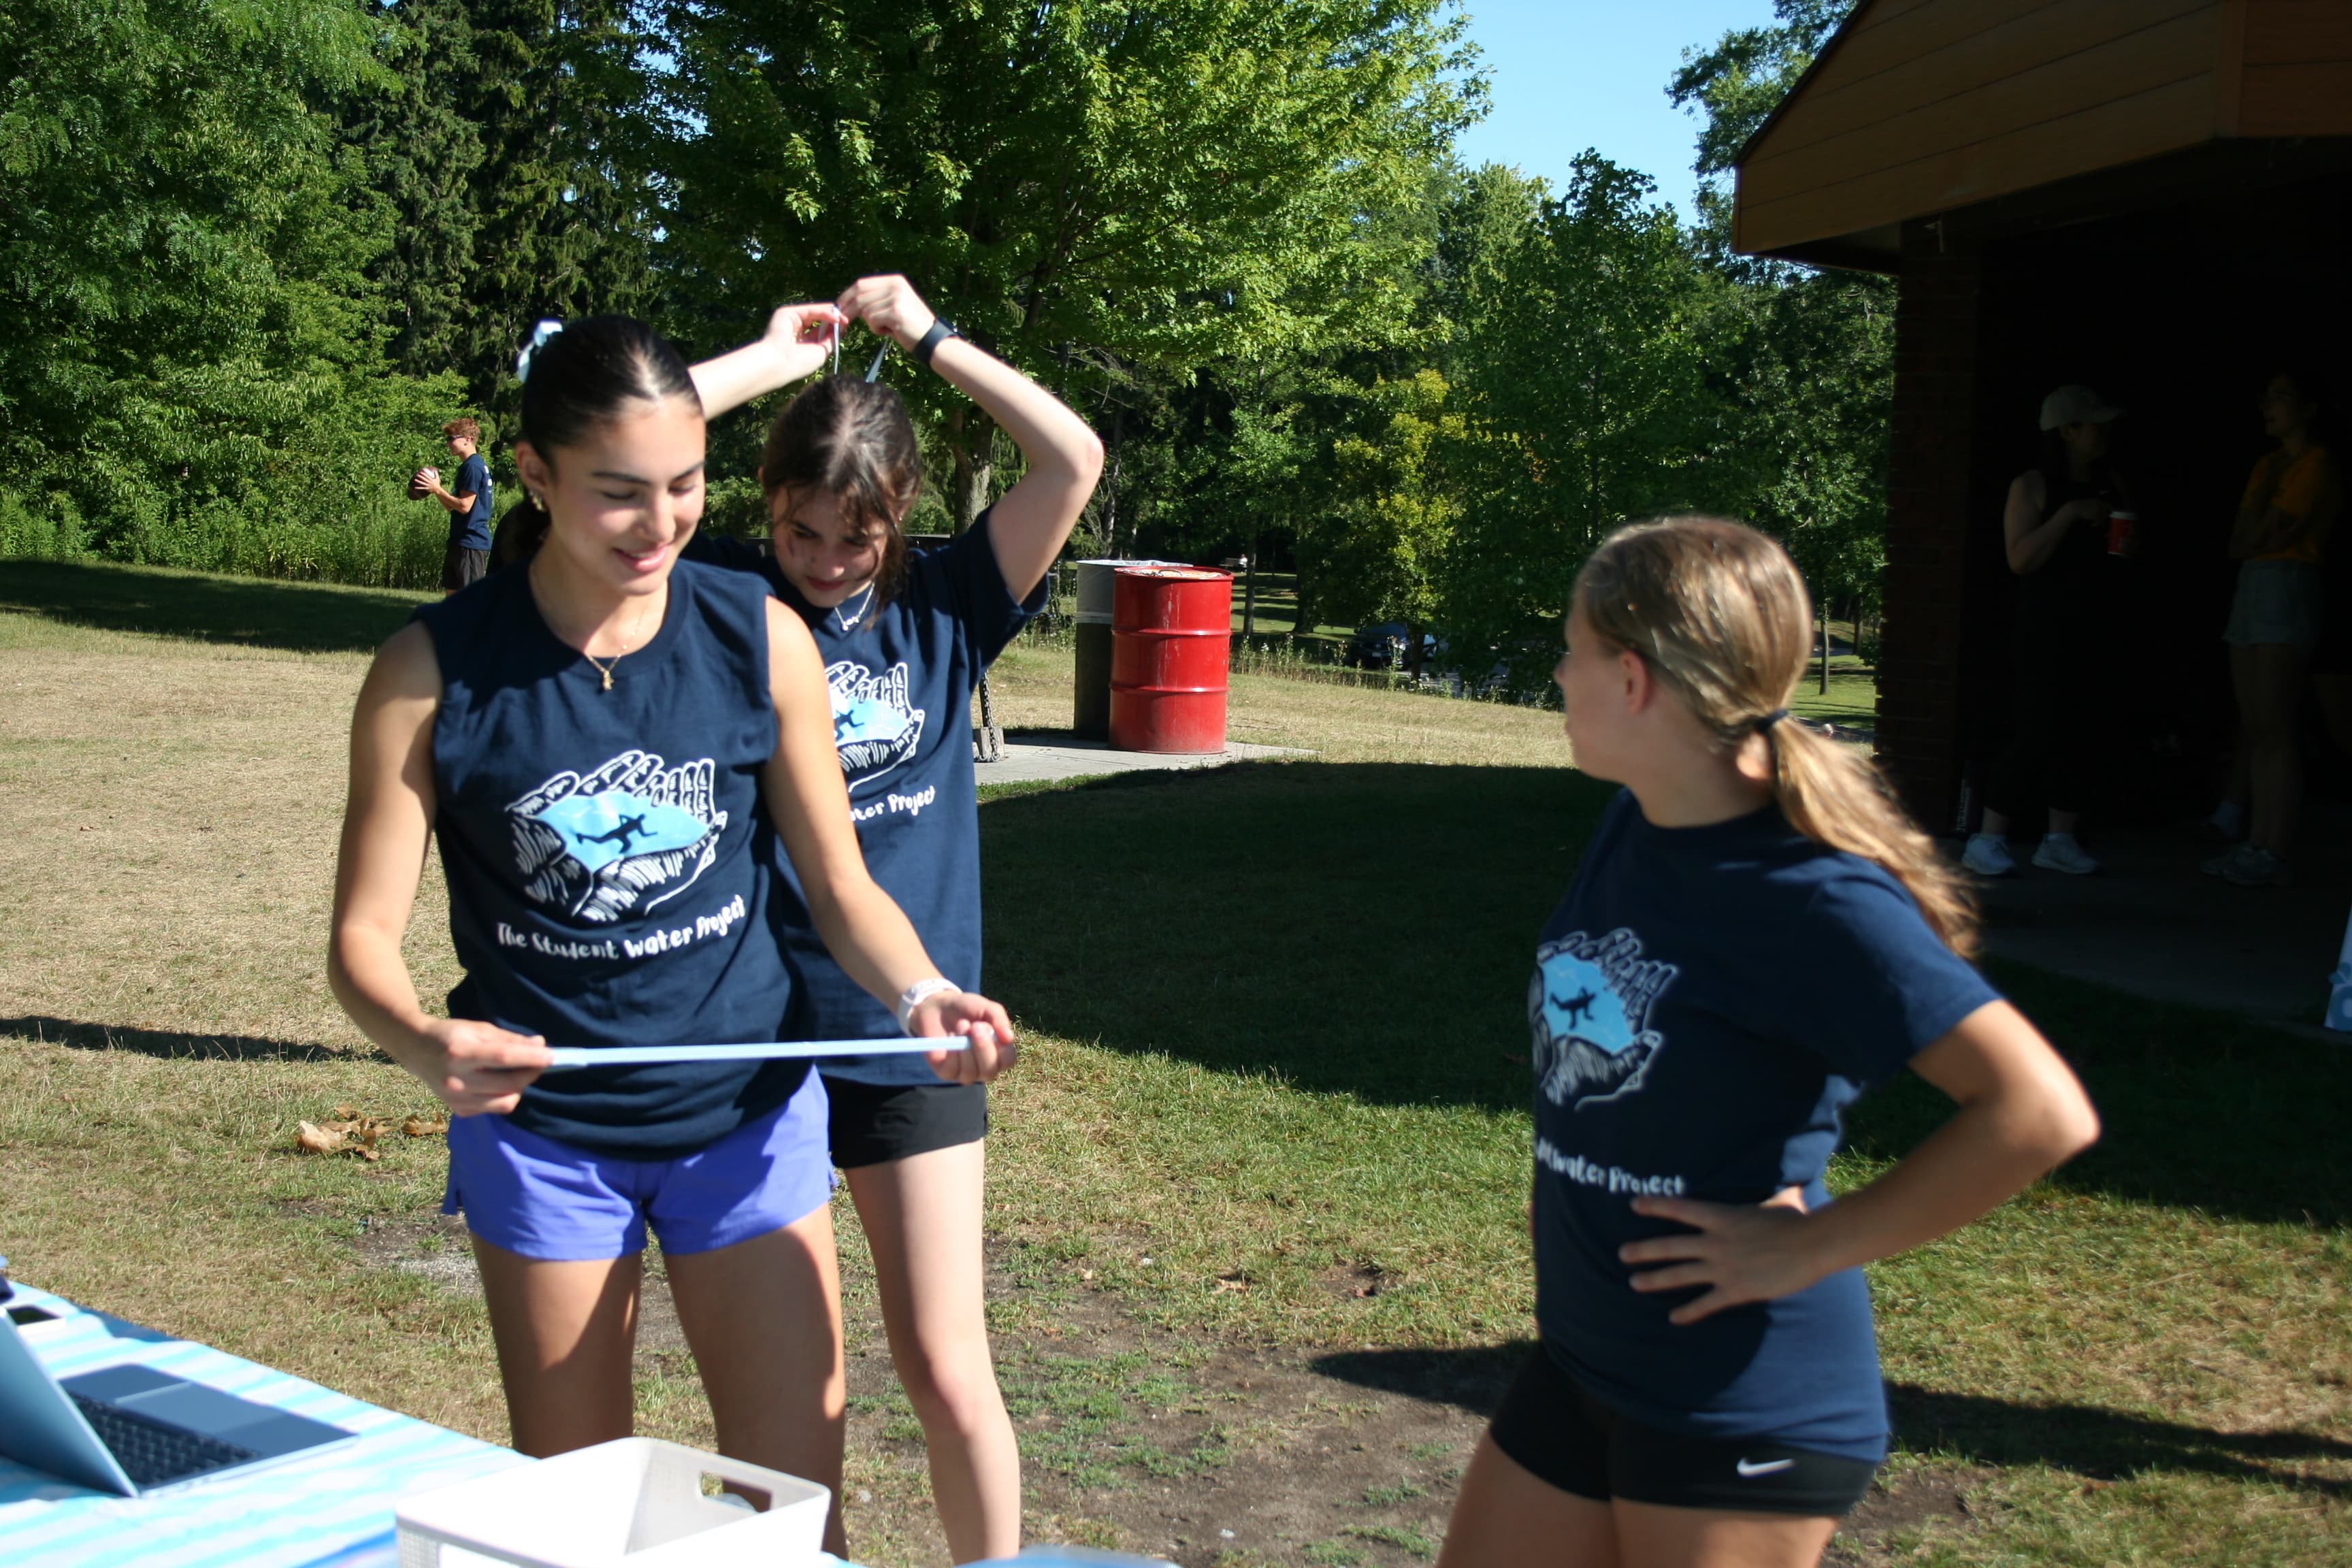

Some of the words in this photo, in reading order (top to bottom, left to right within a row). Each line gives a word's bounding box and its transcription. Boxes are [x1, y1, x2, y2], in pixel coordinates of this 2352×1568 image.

[497, 921, 528, 948] The
[532, 932, 619, 960] Student
[696, 894, 746, 941] Project
[1609, 1164, 1686, 1196] Project
